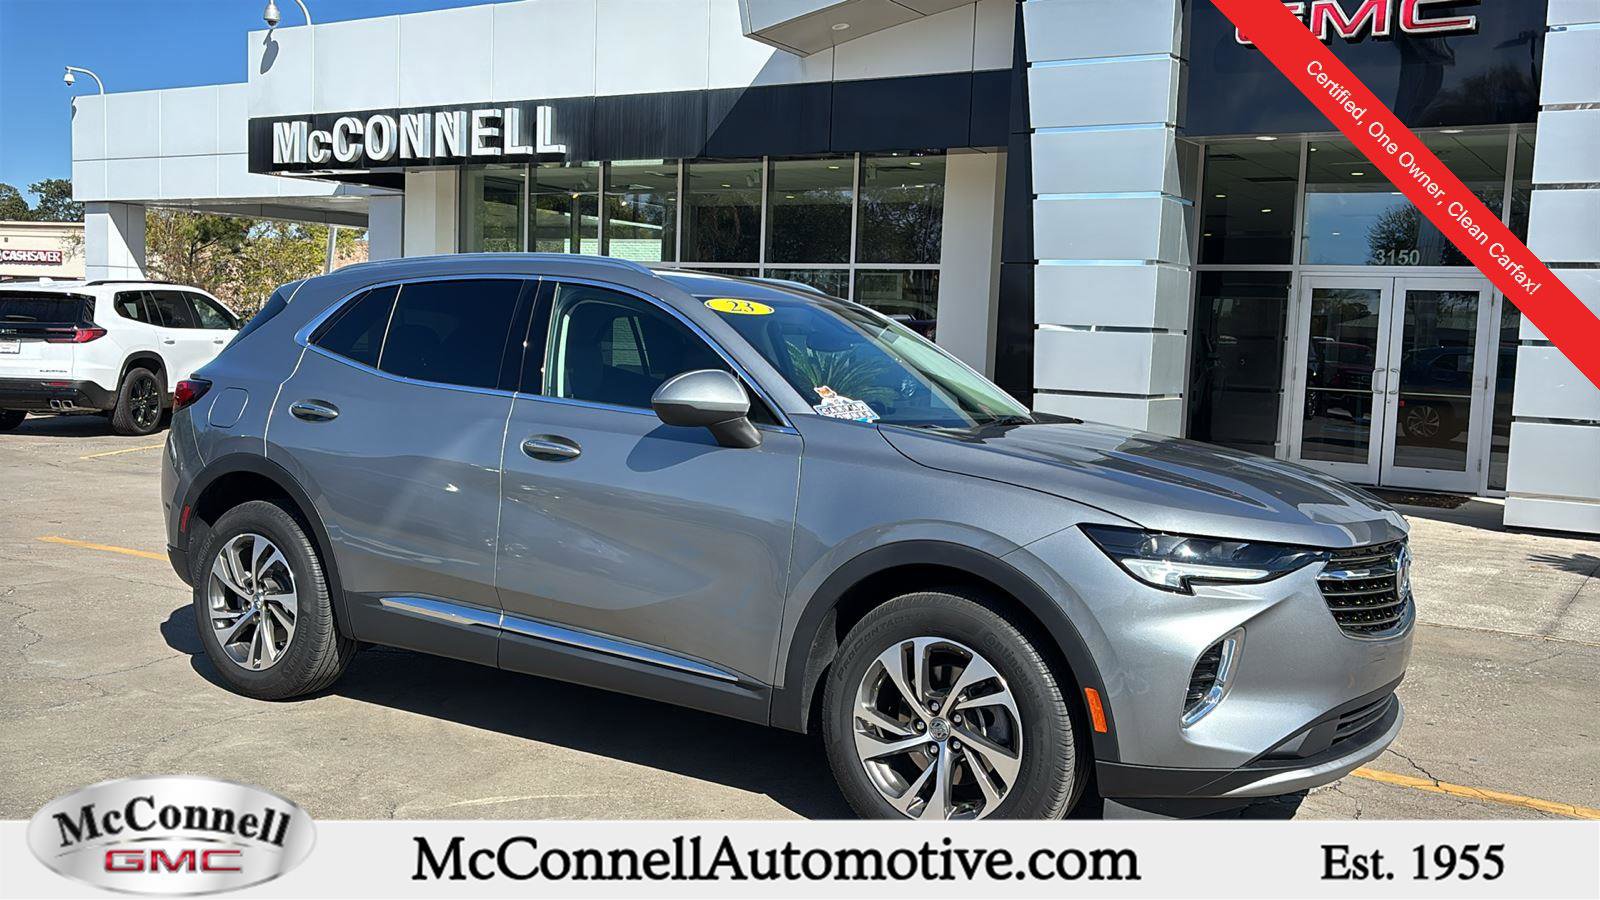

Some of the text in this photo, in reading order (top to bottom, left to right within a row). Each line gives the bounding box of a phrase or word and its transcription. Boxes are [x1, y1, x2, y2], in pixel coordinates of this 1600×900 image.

[272, 106, 566, 164] McCONNELL
[1376, 249, 1421, 266] 3150
[726, 300, 754, 313] 23
